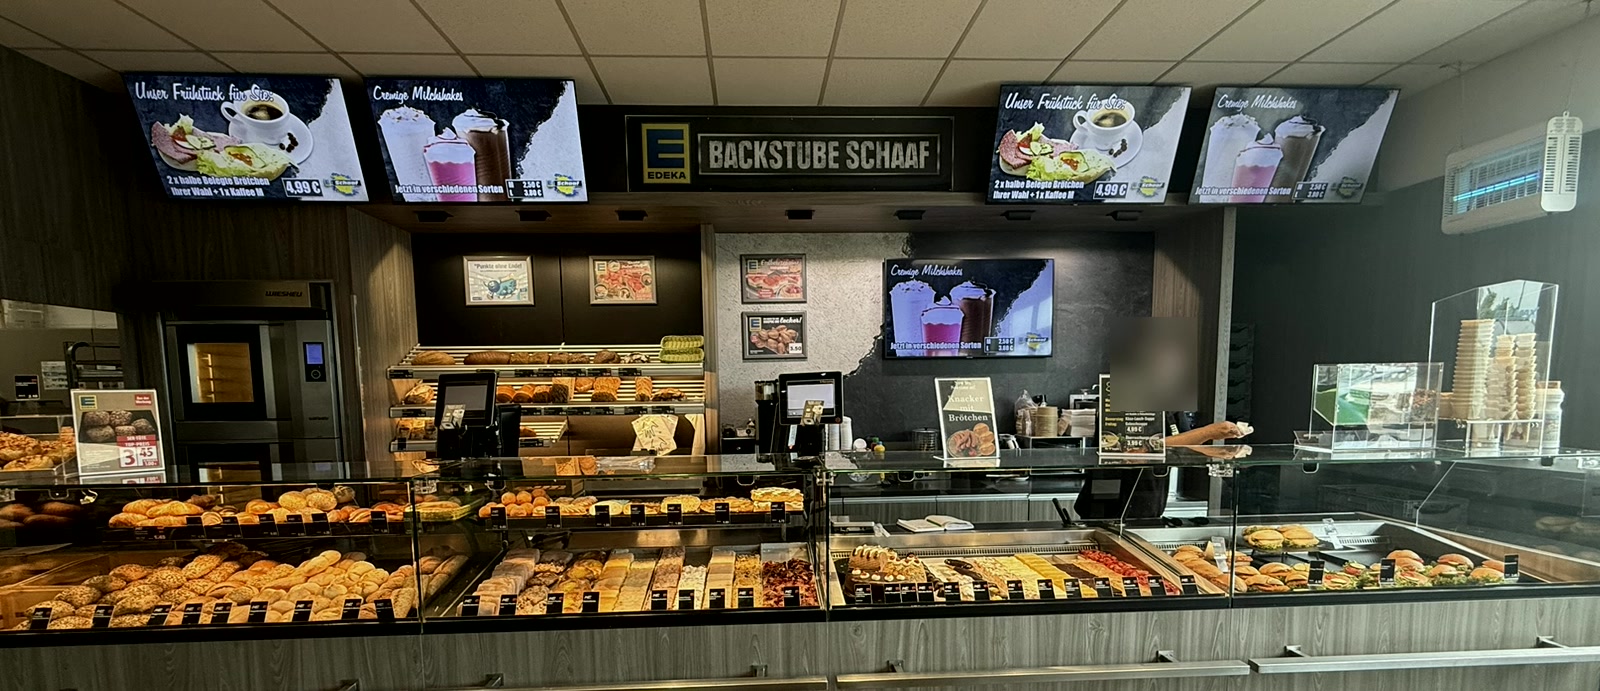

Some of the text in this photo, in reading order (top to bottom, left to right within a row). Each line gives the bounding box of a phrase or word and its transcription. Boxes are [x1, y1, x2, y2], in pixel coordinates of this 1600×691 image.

[134, 81, 275, 102] Unser Frühstück für Sie:
[373, 84, 464, 104] Cremige Milchshakes
[1004, 92, 1127, 111] Unser Frühstück für Sie:
[1217, 94, 1299, 112] Cremige Milchshakes
[708, 140, 930, 170] BACKSTUBE SCHAAF
[166, 175, 173, 185] 2
[179, 175, 202, 185] halbe
[201, 175, 233, 186] Belegte
[232, 175, 270, 186] Brötchen
[646, 171, 687, 180] EDEKA
[286, 180, 321, 196] 4,99 €
[395, 184, 504, 194] Jetzt in verschiedenen Sorten
[994, 180, 1000, 189] 2
[1005, 180, 1025, 189] halbe
[1025, 180, 1053, 190] Belegte
[1052, 180, 1085, 189] Brötchen
[1096, 184, 1128, 197] 4,99 €
[1195, 185, 1292, 195] Jetzt in verschiedenen Sorten
[170, 186, 191, 196] Ihrer
[191, 186, 213, 196] Wahl
[230, 187, 256, 197] Kaffee
[255, 187, 265, 197] M
[993, 190, 1011, 199] Ihrer
[1011, 190, 1030, 199] Wahl
[1044, 190, 1068, 199] Kaffee
[1067, 190, 1075, 199] M
[890, 264, 964, 279] Cremige Milchshakes
[890, 342, 905, 350] Jetzt
[960, 341, 982, 349] Sorten
[947, 394, 985, 403] Knacker
[948, 413, 989, 422] Brötchen
[122, 448, 136, 466] 3
[139, 447, 154, 458] 45
